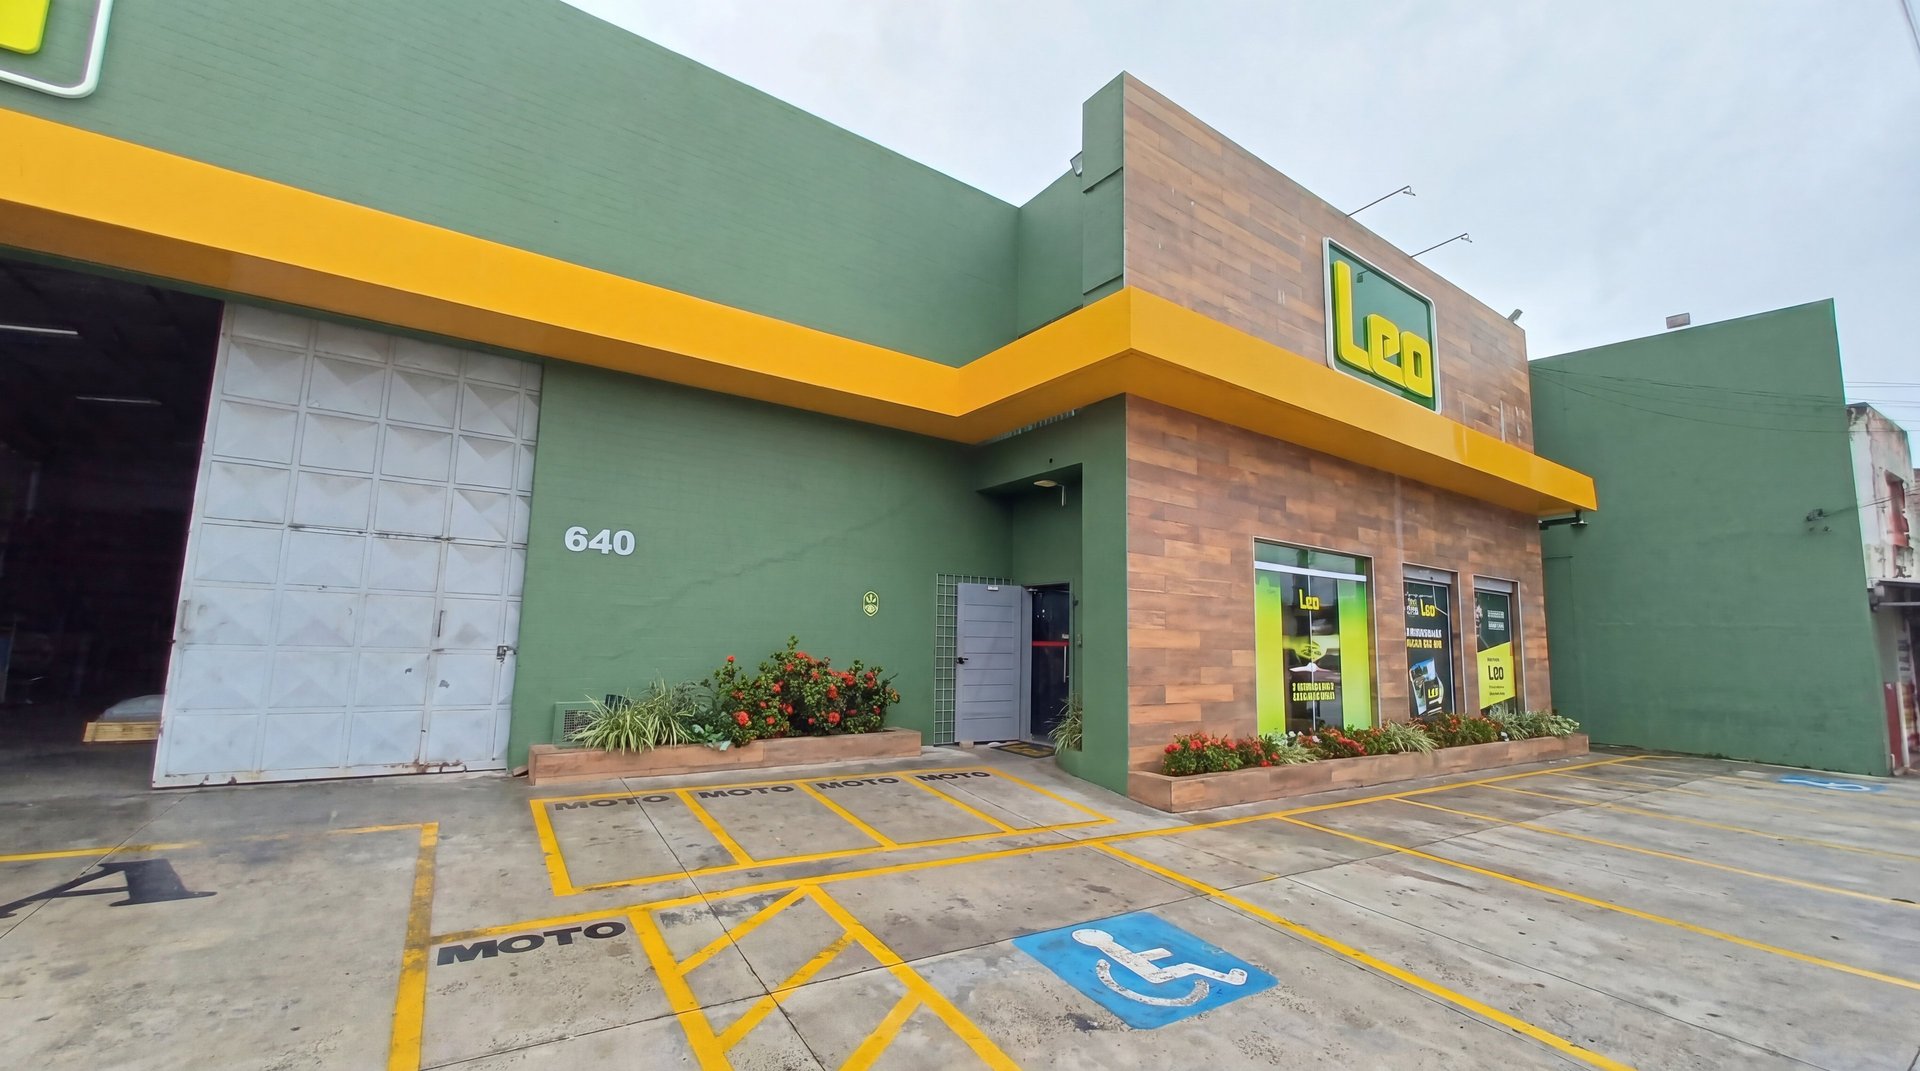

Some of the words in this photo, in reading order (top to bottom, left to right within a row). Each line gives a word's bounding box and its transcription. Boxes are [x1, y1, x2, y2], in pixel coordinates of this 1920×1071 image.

[1333, 260, 1434, 399] Leo
[564, 526, 636, 556] 640
[1299, 588, 1320, 611] Leo
[1488, 665, 1504, 681] Leo
[815, 777, 900, 790] MOTO
[914, 771, 991, 782] MOTO
[697, 785, 795, 799] MOTO
[554, 795, 670, 811] MOTO
[436, 921, 627, 966] MOTO
